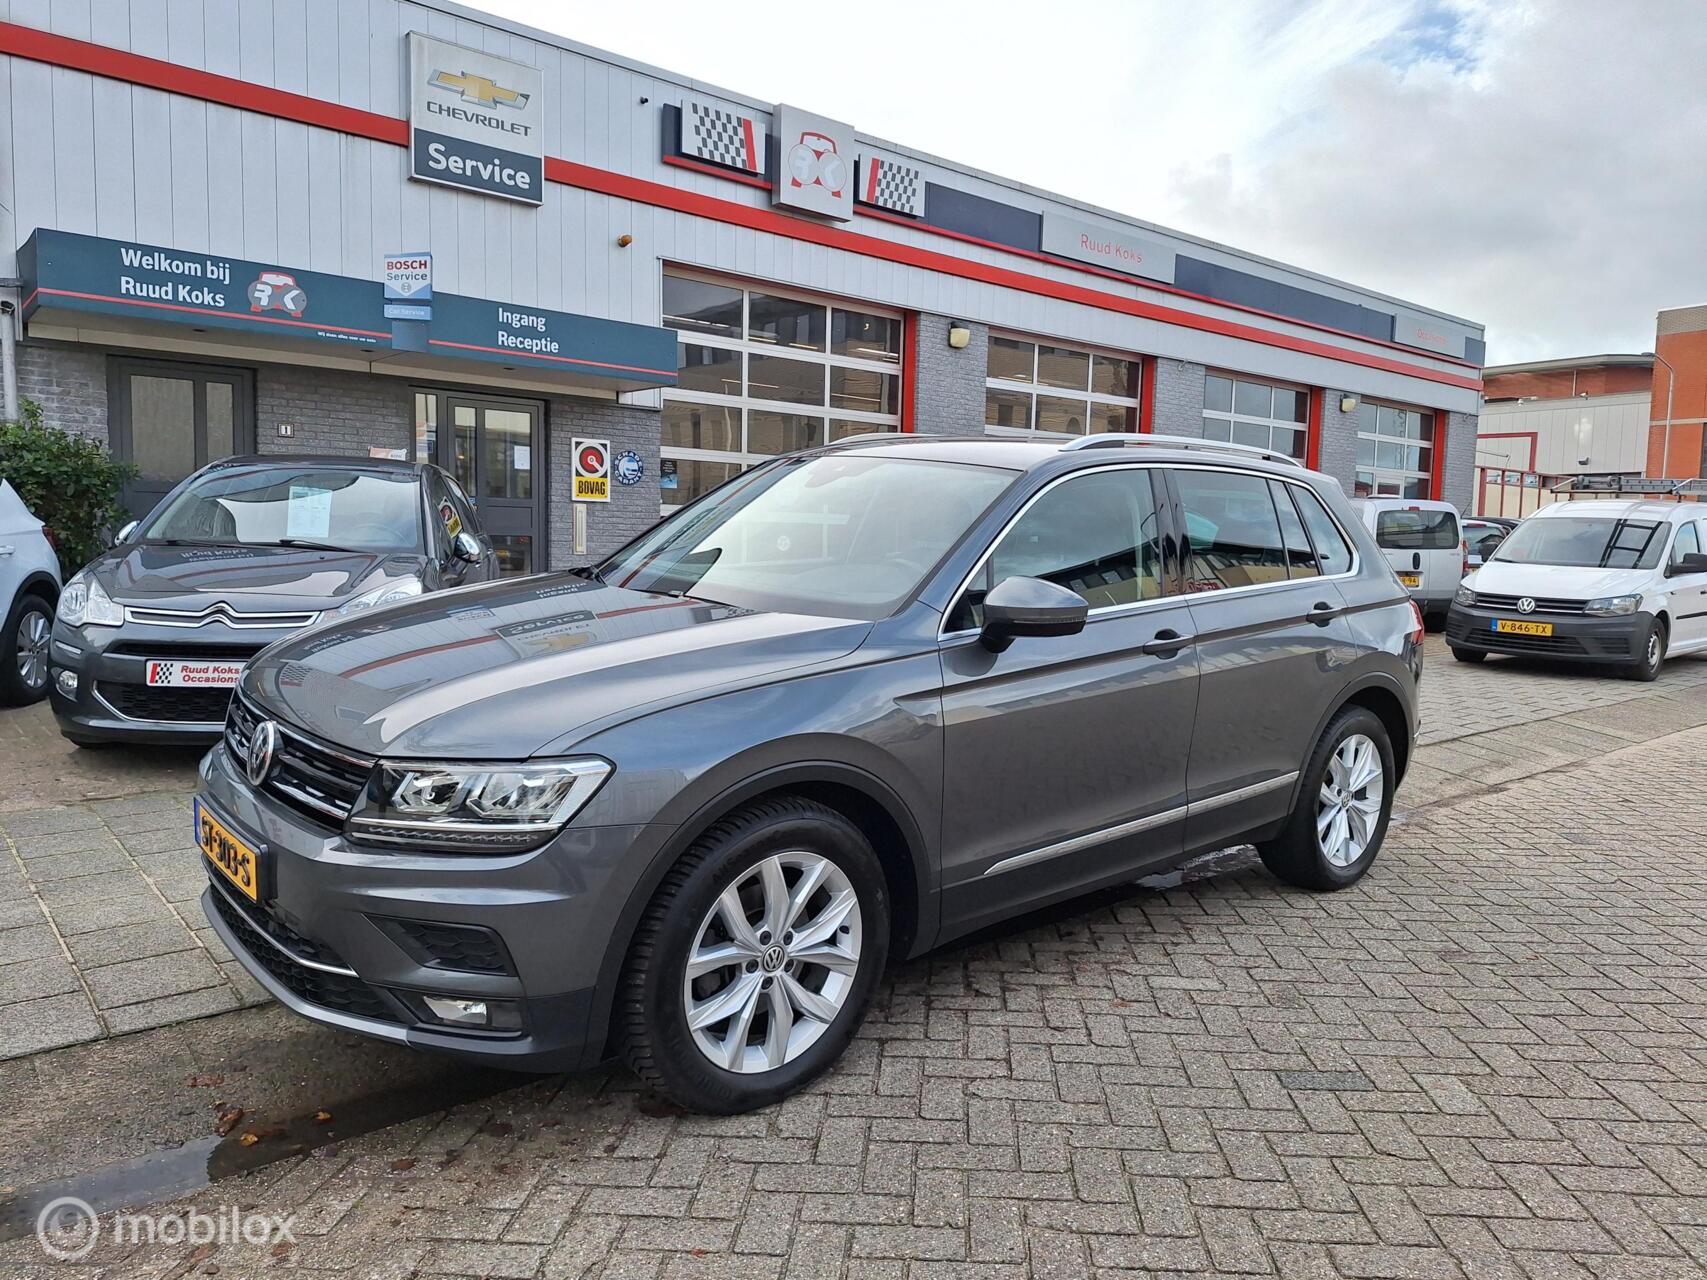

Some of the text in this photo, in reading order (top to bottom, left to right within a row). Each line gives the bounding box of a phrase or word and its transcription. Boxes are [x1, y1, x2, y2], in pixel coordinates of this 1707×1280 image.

[427, 101, 531, 137] CHEVROLET
[428, 142, 531, 190] Service
[1080, 233, 1111, 255] Ruud
[120, 247, 230, 285] Welkom bij
[386, 260, 428, 271] BOSCH
[386, 272, 428, 281] Service
[120, 276, 225, 308] Ruud Koks
[498, 307, 546, 332] Ingang
[497, 330, 559, 354] Receptie
[578, 480, 606, 496] BOVAG
[1500, 621, 1548, 634] V-846-TX
[180, 665, 240, 676] Ruud Koks
[182, 674, 239, 684] Occasions
